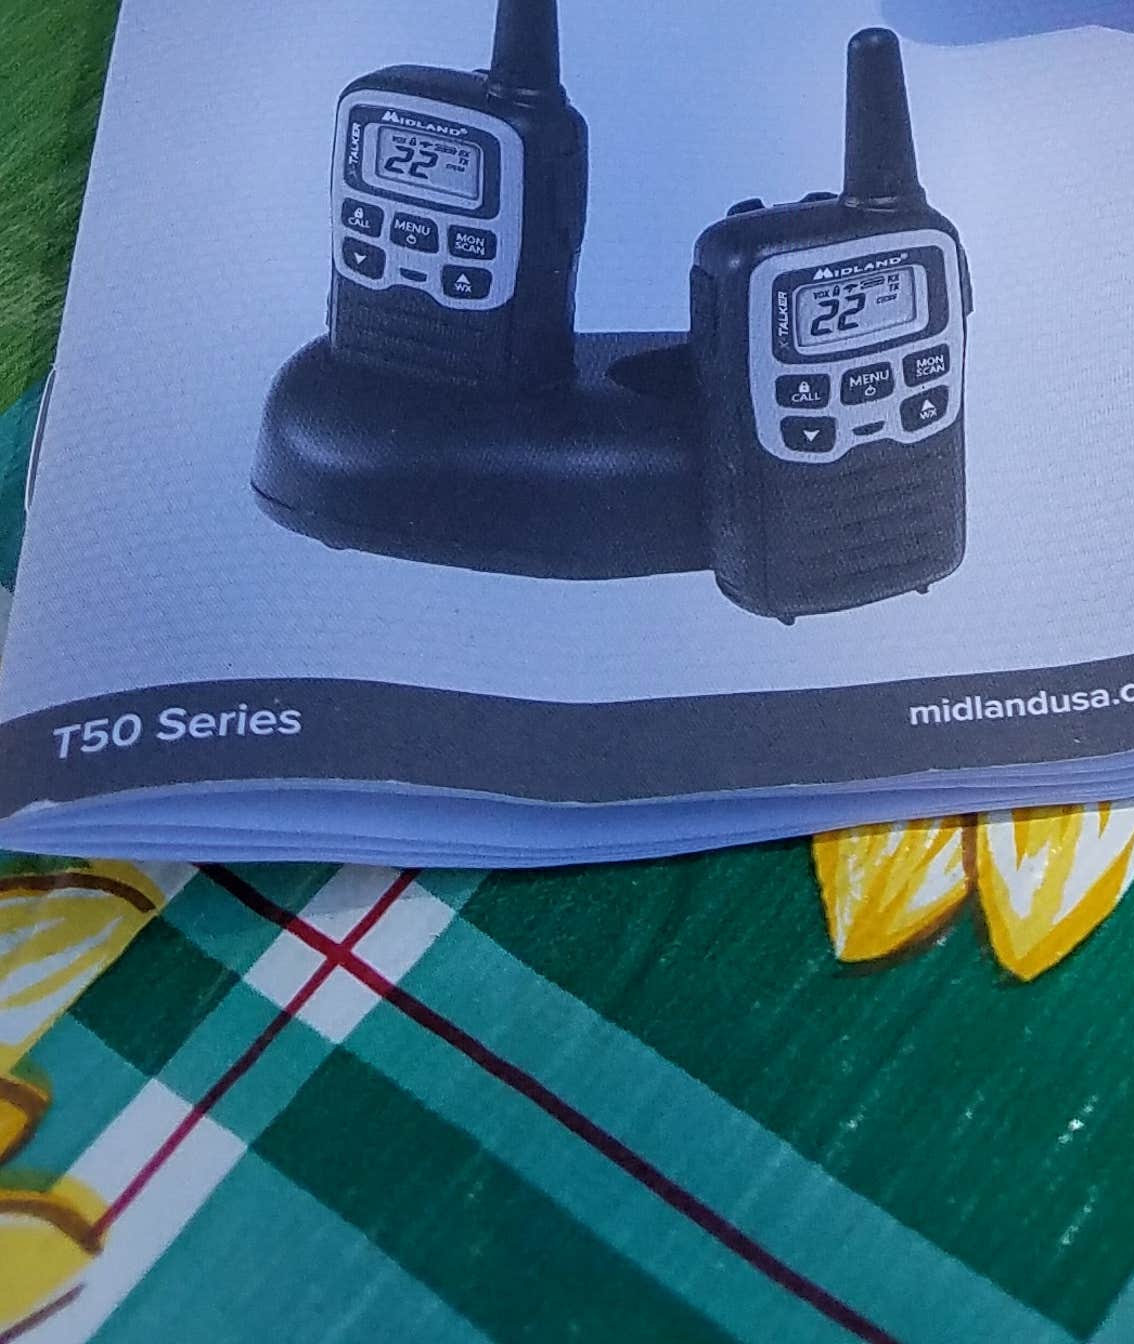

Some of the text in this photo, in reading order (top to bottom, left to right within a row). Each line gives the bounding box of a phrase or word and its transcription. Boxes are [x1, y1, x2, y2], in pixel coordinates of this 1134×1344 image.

[384, 145, 439, 180] 22
[348, 216, 371, 229] CALL
[394, 219, 431, 237] MENU
[456, 233, 485, 247] MON
[455, 241, 485, 256] SCAN
[454, 282, 472, 294] WX
[810, 292, 866, 337] 22
[916, 354, 944, 367] MON
[915, 362, 945, 377] SCAN
[849, 369, 890, 388] MENU
[791, 391, 821, 402] CALL
[52, 699, 303, 762] T50 Series
